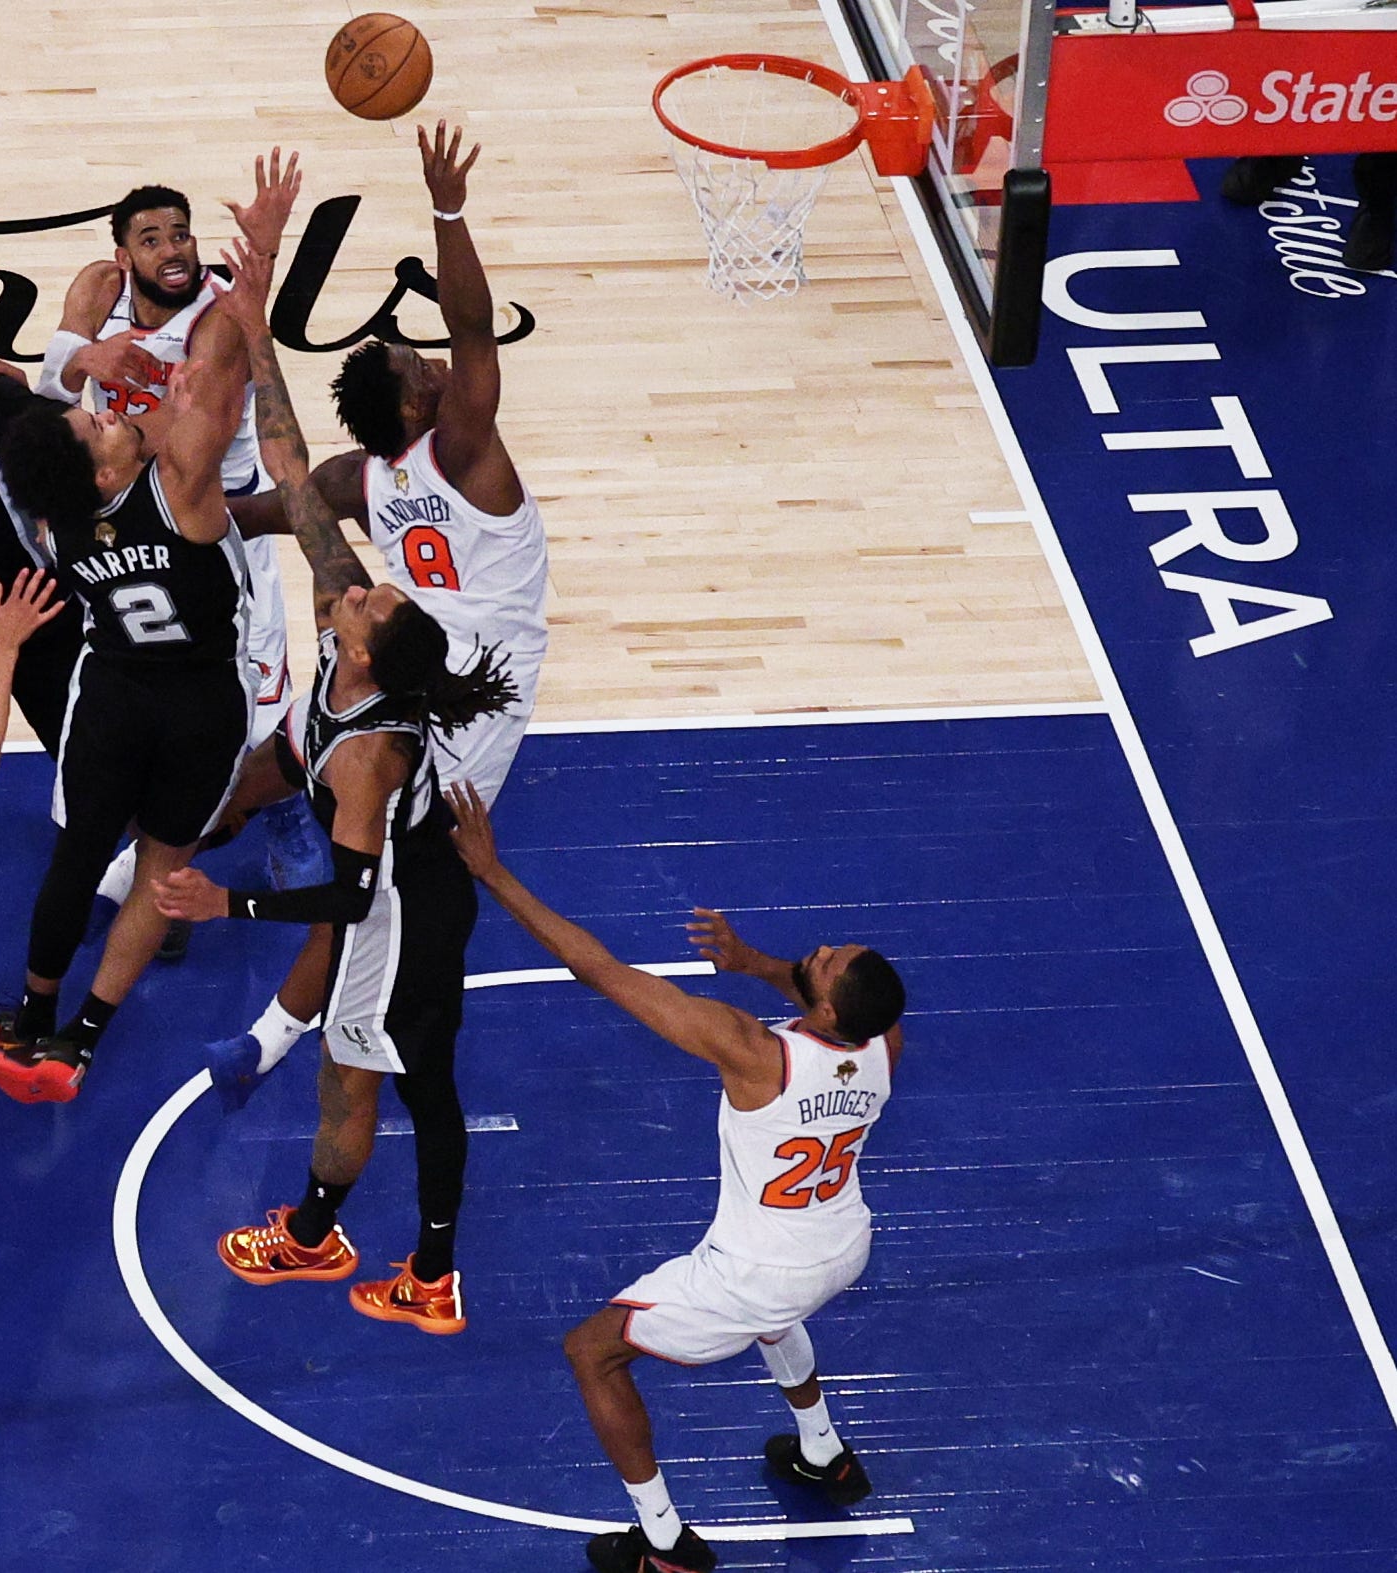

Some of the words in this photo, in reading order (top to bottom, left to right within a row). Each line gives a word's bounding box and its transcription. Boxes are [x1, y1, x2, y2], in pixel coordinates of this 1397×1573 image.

[1254, 70, 1397, 123] State
[1042, 249, 1334, 658] ULTRA
[72, 545, 171, 584] HARPER
[402, 525, 461, 592] 8
[108, 582, 192, 646] 2
[798, 1090, 876, 1125] BRIDGES
[759, 1124, 870, 1210] 25
